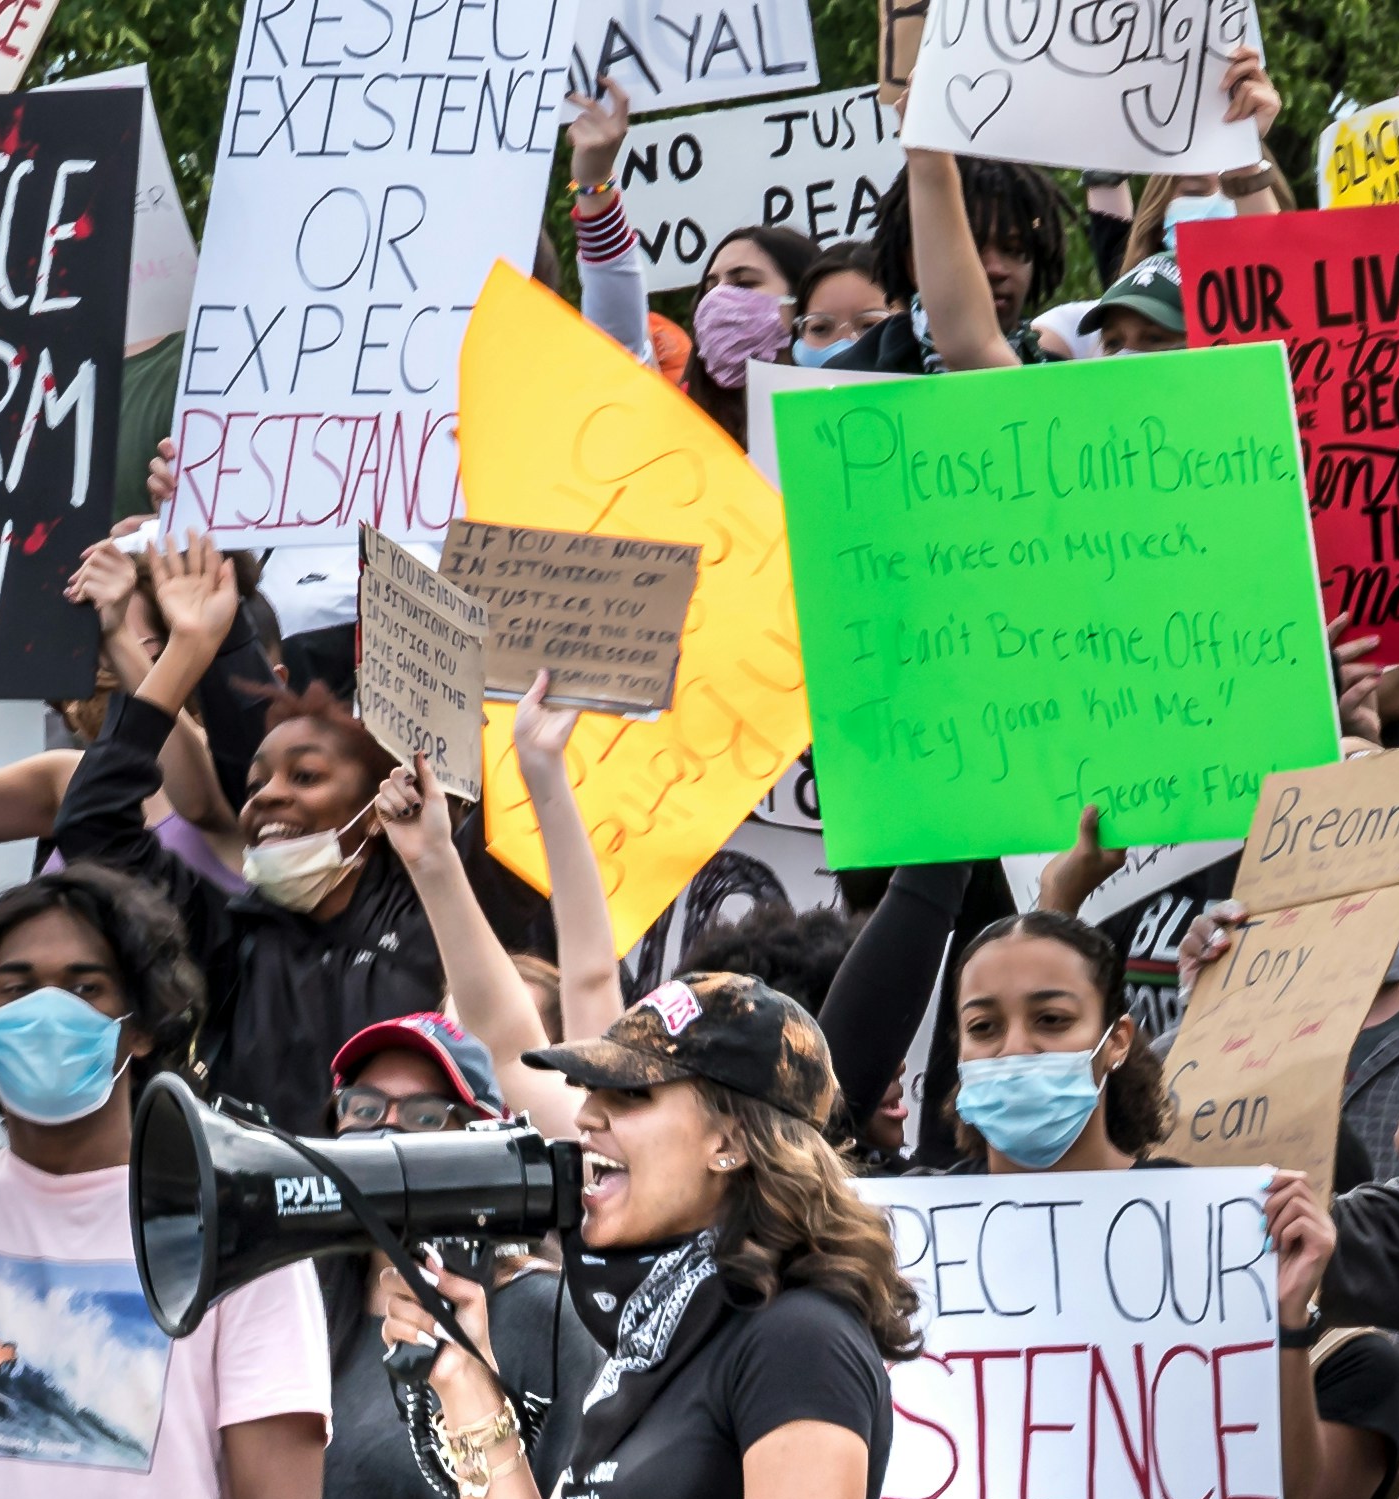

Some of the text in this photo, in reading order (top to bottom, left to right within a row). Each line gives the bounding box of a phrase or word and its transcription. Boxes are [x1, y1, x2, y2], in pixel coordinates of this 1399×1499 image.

[227, 68, 567, 158] EXISTENCE
[622, 89, 902, 191] NO JUST
[295, 184, 428, 294] OR
[1198, 262, 1292, 334] OUR
[165, 407, 464, 537] RESISTANC
[389, 544, 415, 585] YOU
[450, 552, 486, 576] IN
[455, 521, 496, 550] IF
[506, 528, 557, 553] YOU
[837, 542, 910, 583] The
[1009, 535, 1049, 566] on
[603, 599, 647, 618] YOU
[434, 647, 457, 677] YOU
[1221, 919, 1315, 1003] Tony
[891, 1197, 1274, 1325] PECT OUR
